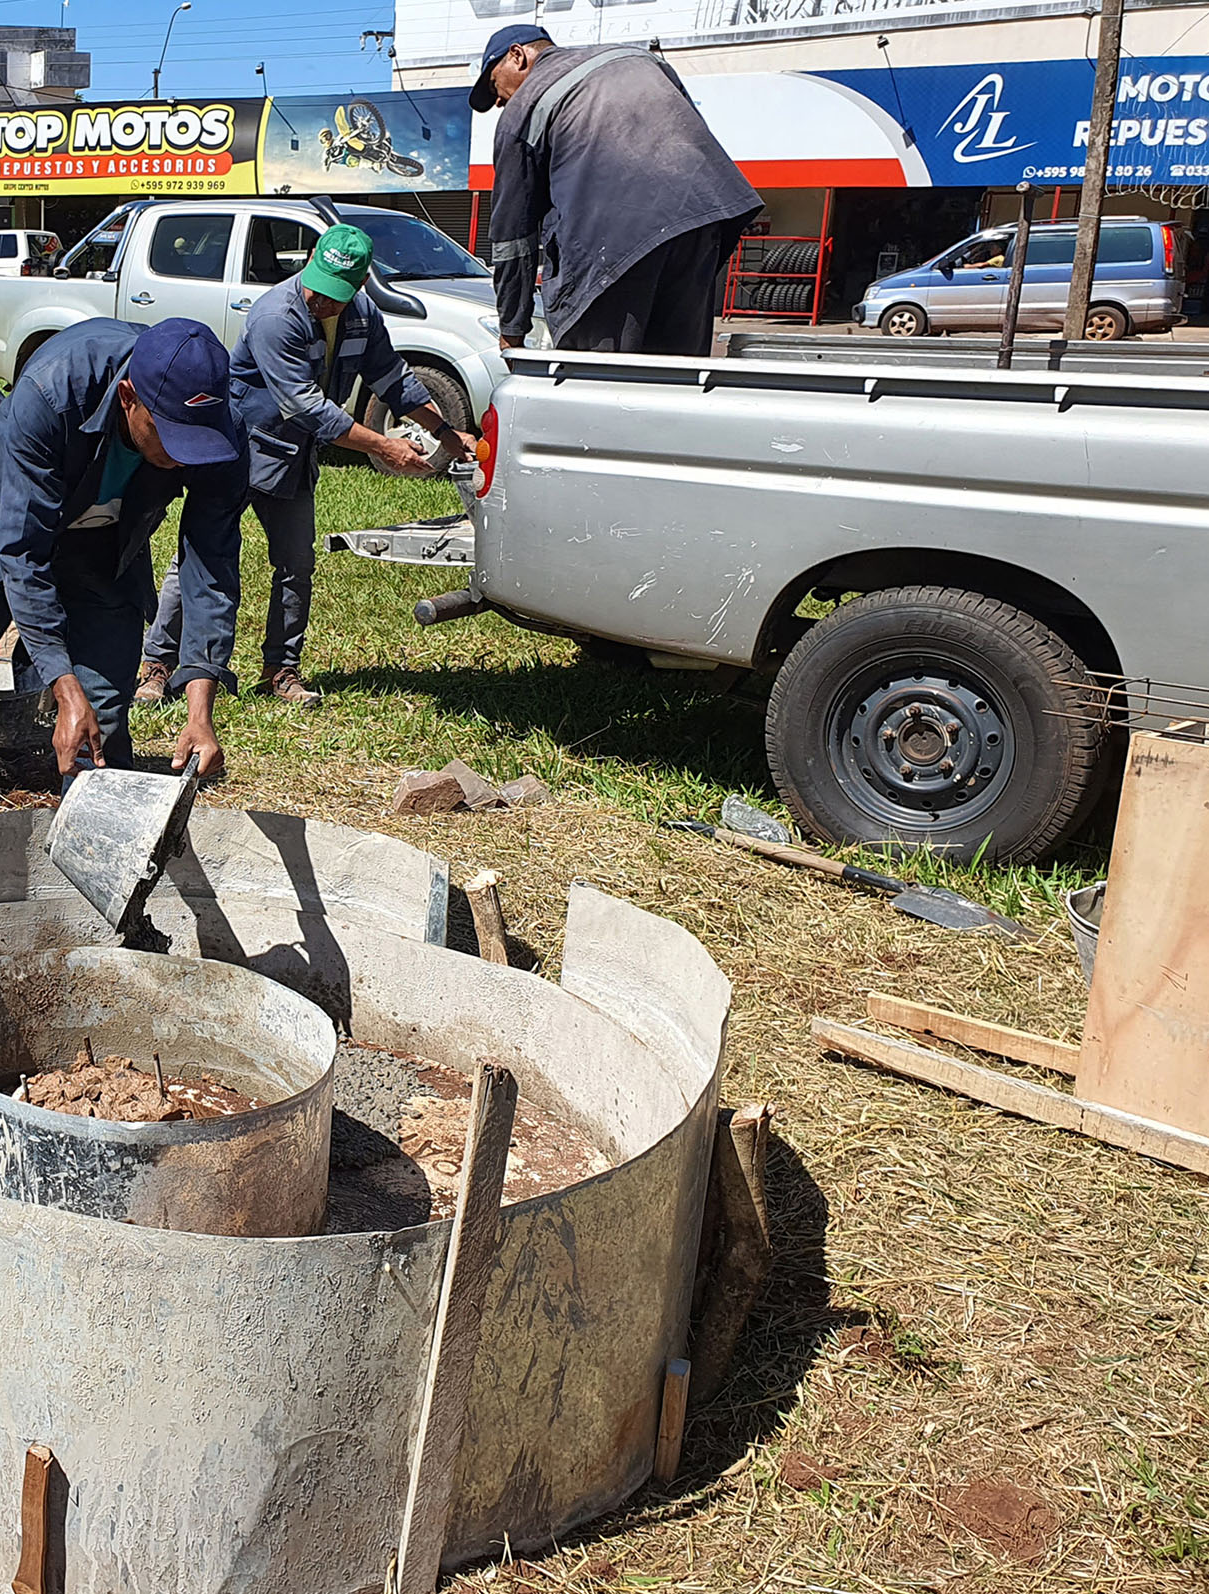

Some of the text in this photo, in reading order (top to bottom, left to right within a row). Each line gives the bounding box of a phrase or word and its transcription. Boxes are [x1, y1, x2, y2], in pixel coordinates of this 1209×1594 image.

[72, 109, 229, 151] MOTOS
[92, 160, 100, 174] Y
[107, 158, 217, 173] ACCESORIOS
[1036, 166, 1067, 178] +595
[1115, 165, 1133, 177] 80
[1134, 164, 1152, 177] 26
[141, 180, 226, 190] +595 972 939 969
